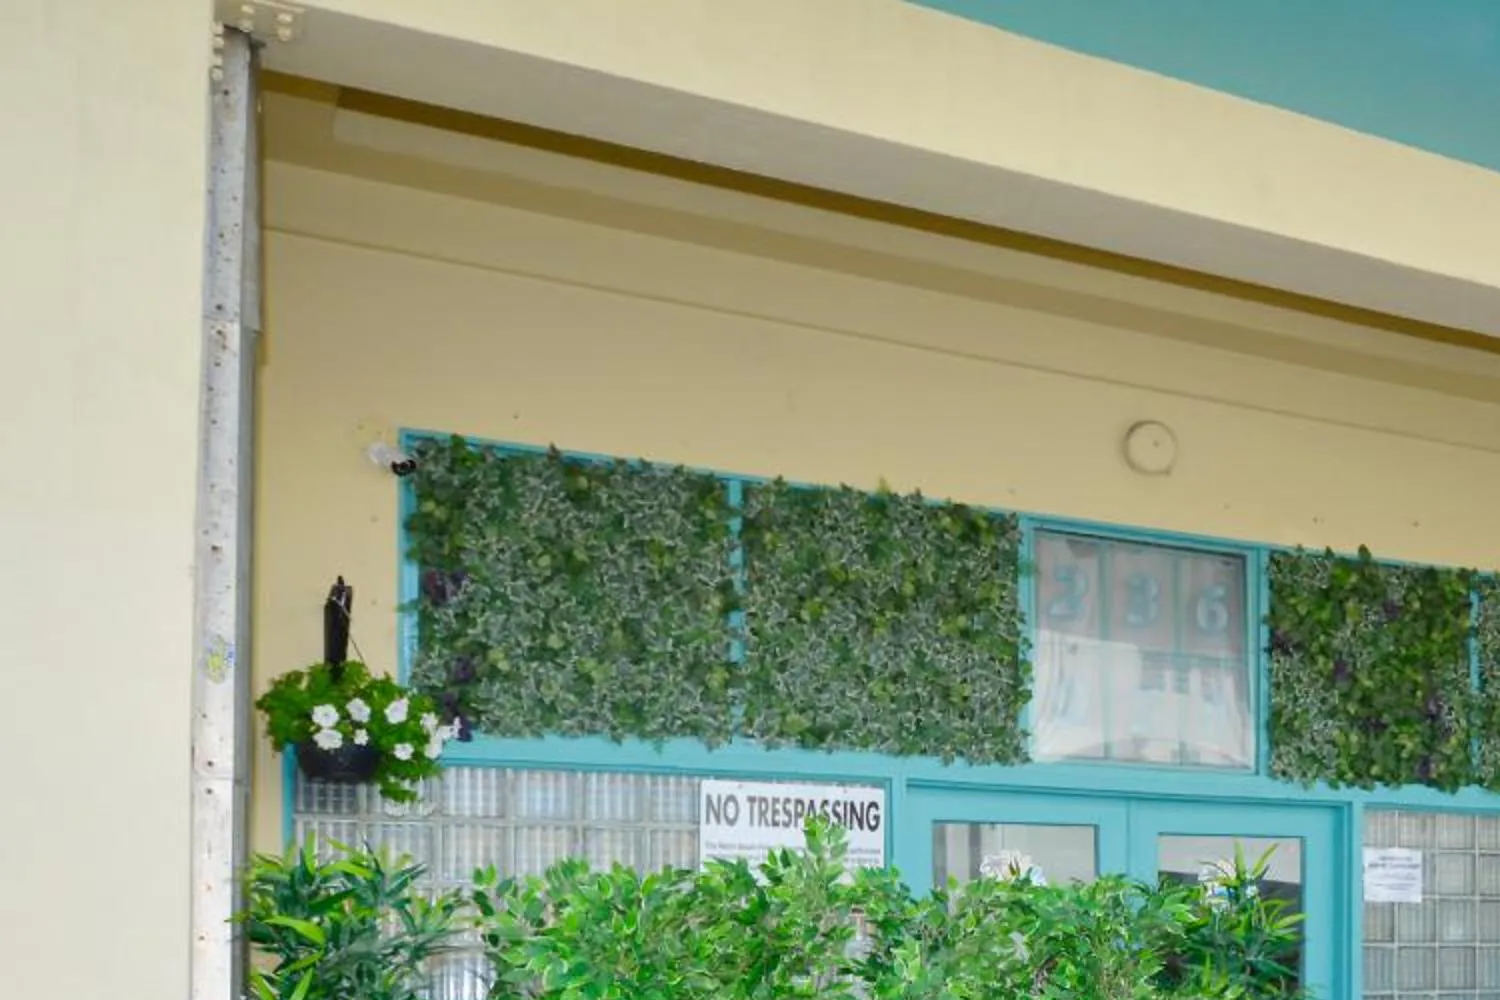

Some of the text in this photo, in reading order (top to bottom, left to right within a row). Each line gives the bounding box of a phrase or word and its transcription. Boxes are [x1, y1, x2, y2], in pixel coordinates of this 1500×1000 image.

[1046, 564, 1229, 634] 236
[705, 793, 881, 832] NO TRESPASSING
